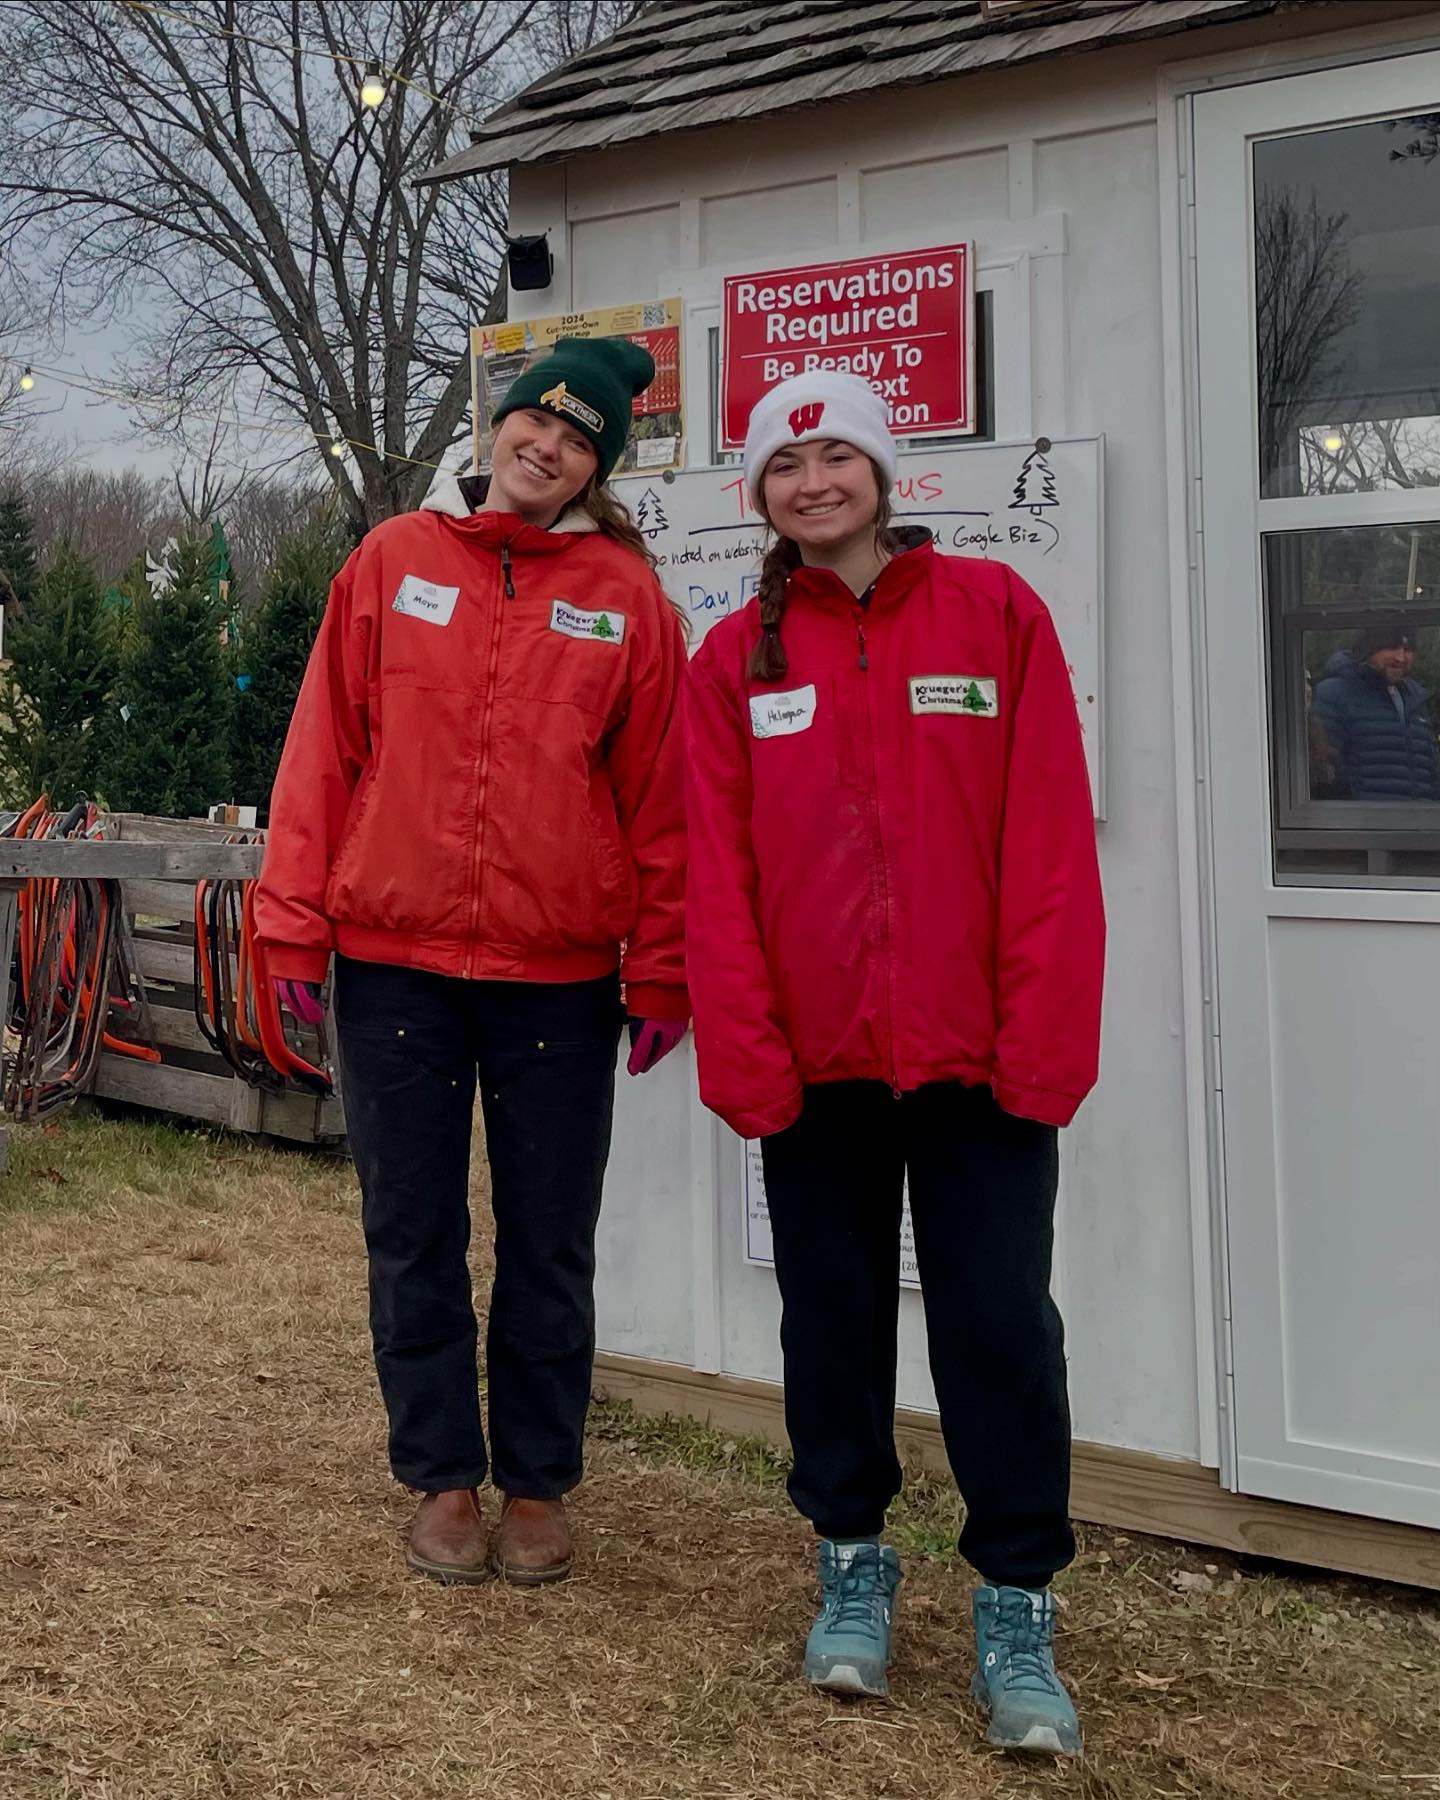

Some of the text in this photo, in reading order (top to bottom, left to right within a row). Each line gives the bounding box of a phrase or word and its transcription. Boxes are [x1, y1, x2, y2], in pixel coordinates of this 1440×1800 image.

[737, 262, 954, 314] Reservations
[561, 314, 585, 325] 2024
[766, 293, 919, 345] Required
[763, 343, 922, 382] Be Ready To
[864, 374, 910, 397] ext
[953, 524, 1002, 551] Google
[671, 544, 705, 566] noted
[708, 551, 721, 562] on
[688, 584, 731, 619] Day
[556, 607, 598, 625] Krueger's
[915, 685, 968, 695] Krueger's
